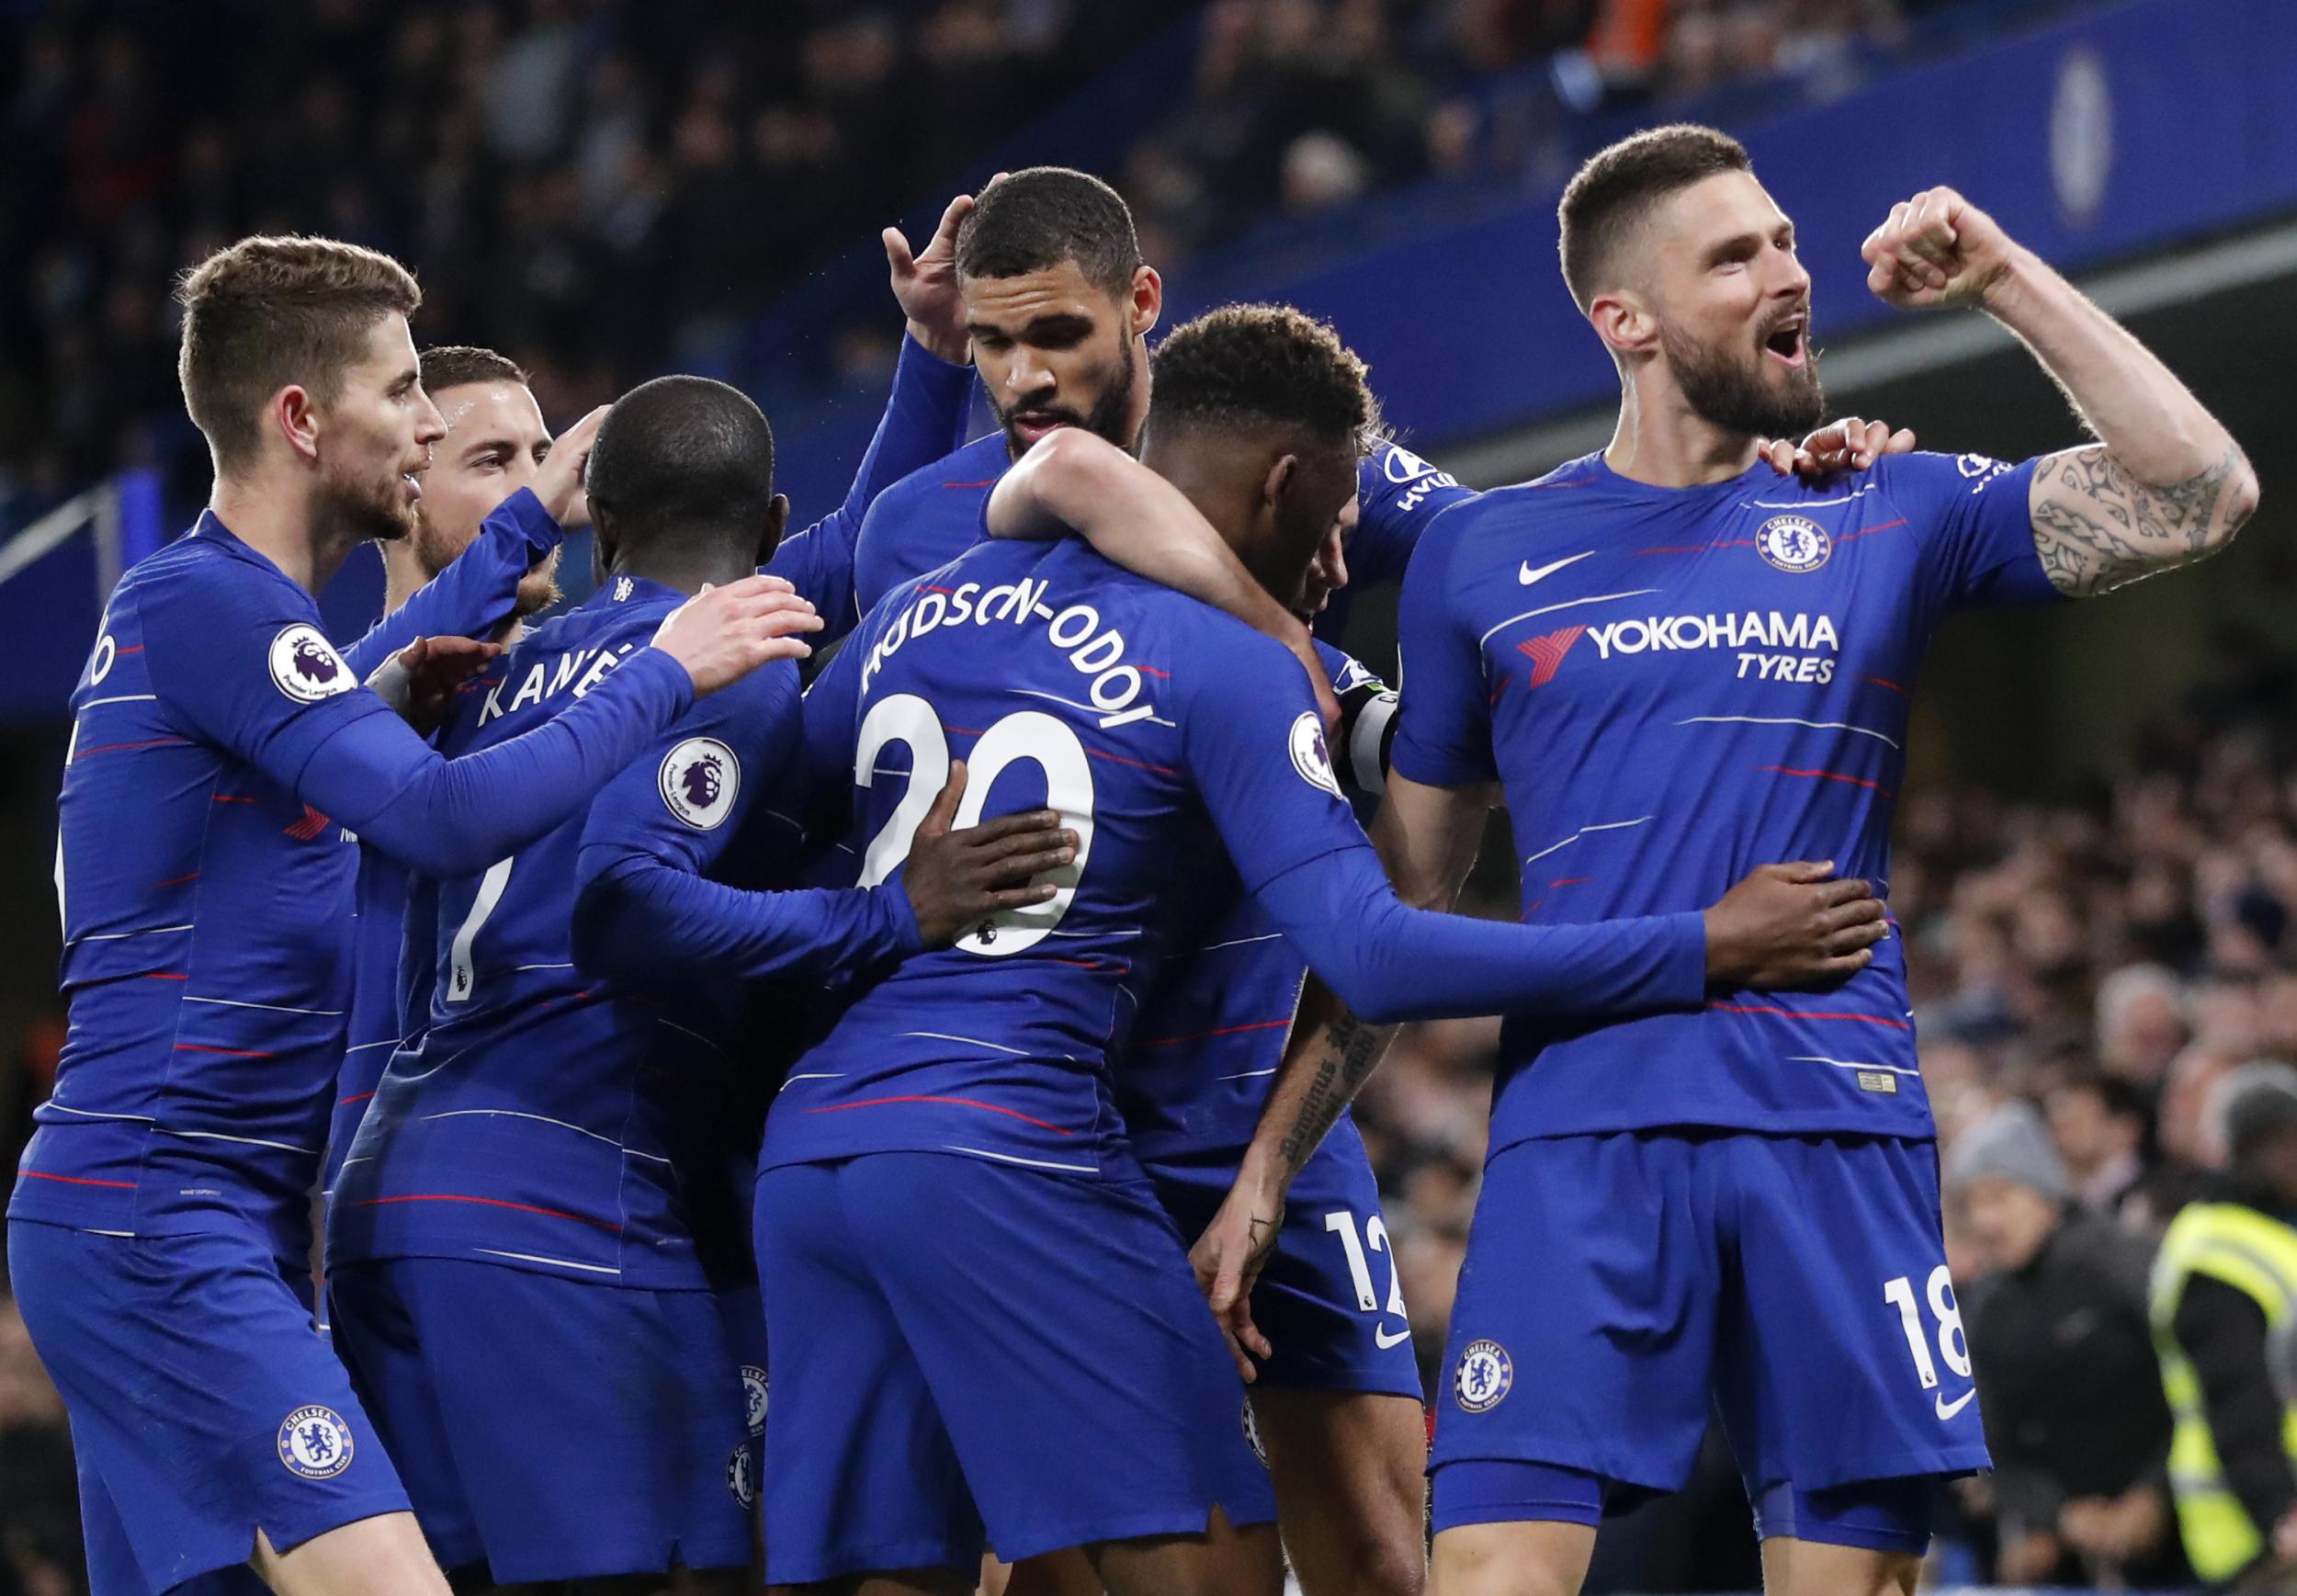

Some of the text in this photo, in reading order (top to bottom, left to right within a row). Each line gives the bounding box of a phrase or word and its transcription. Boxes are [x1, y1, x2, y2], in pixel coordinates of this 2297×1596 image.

[1767, 517, 1814, 531] CHELSEA
[862, 577, 1154, 729] HUDSON-ODOI
[1587, 611, 1839, 660] YOKOHAMA
[1737, 652, 1835, 685] TYRES
[477, 643, 634, 728] KANÉ
[855, 693, 1095, 956] 20
[1325, 1211, 1408, 1320] 12
[1464, 1343, 1500, 1360] CHELSEA
[1884, 1264, 1972, 1389] 18
[285, 1408, 331, 1431] CHELSEA
